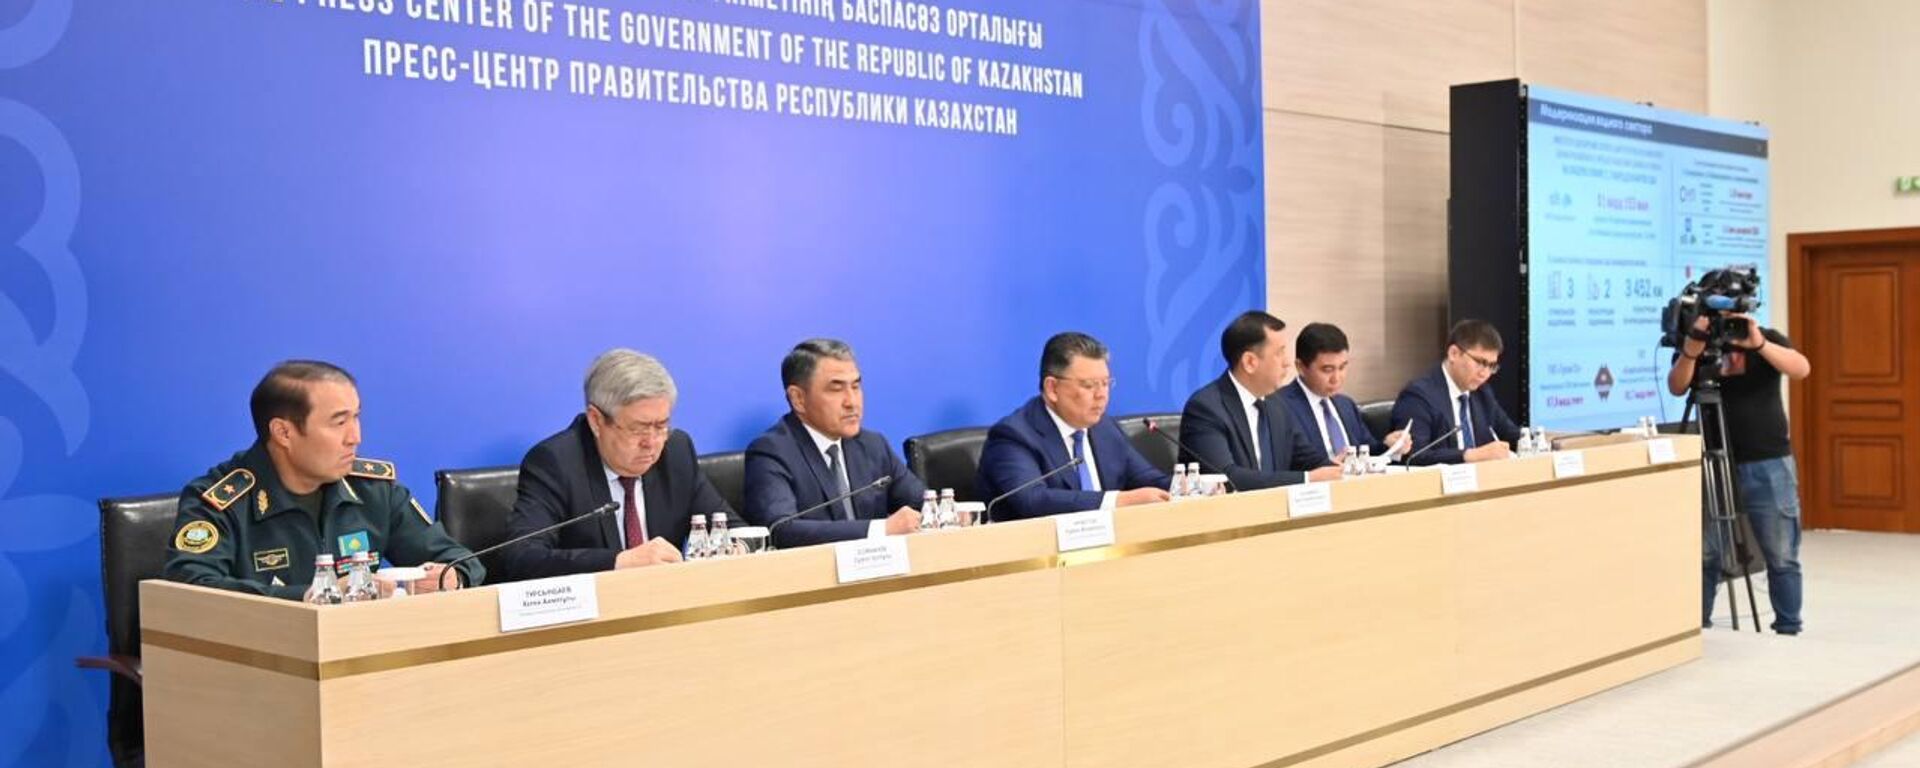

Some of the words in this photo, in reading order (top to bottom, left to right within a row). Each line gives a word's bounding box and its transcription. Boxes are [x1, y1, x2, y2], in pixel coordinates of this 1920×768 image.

[406, 0, 513, 30] CENTER
[523, 0, 554, 33] OF
[563, 3, 611, 42] THE
[620, 11, 773, 61] GOVERNMENT
[780, 32, 805, 64] OF
[811, 36, 850, 70] THE
[856, 43, 946, 81] REPUBLIC
[951, 55, 972, 84] OF
[978, 59, 1083, 98] KAZAKHSTAN
[842, 0, 940, 34] БАСПАСӨЗ
[946, 8, 1042, 49] ОРТАЛЫҒЫ
[364, 38, 560, 91] ПРЕСС-ЦЕНТР
[569, 60, 769, 112] ПРАВИТЕЛЬСТВА
[775, 82, 908, 125] РЕСПУБЛИКИ
[914, 98, 1017, 135] КАЗАХСТАН
